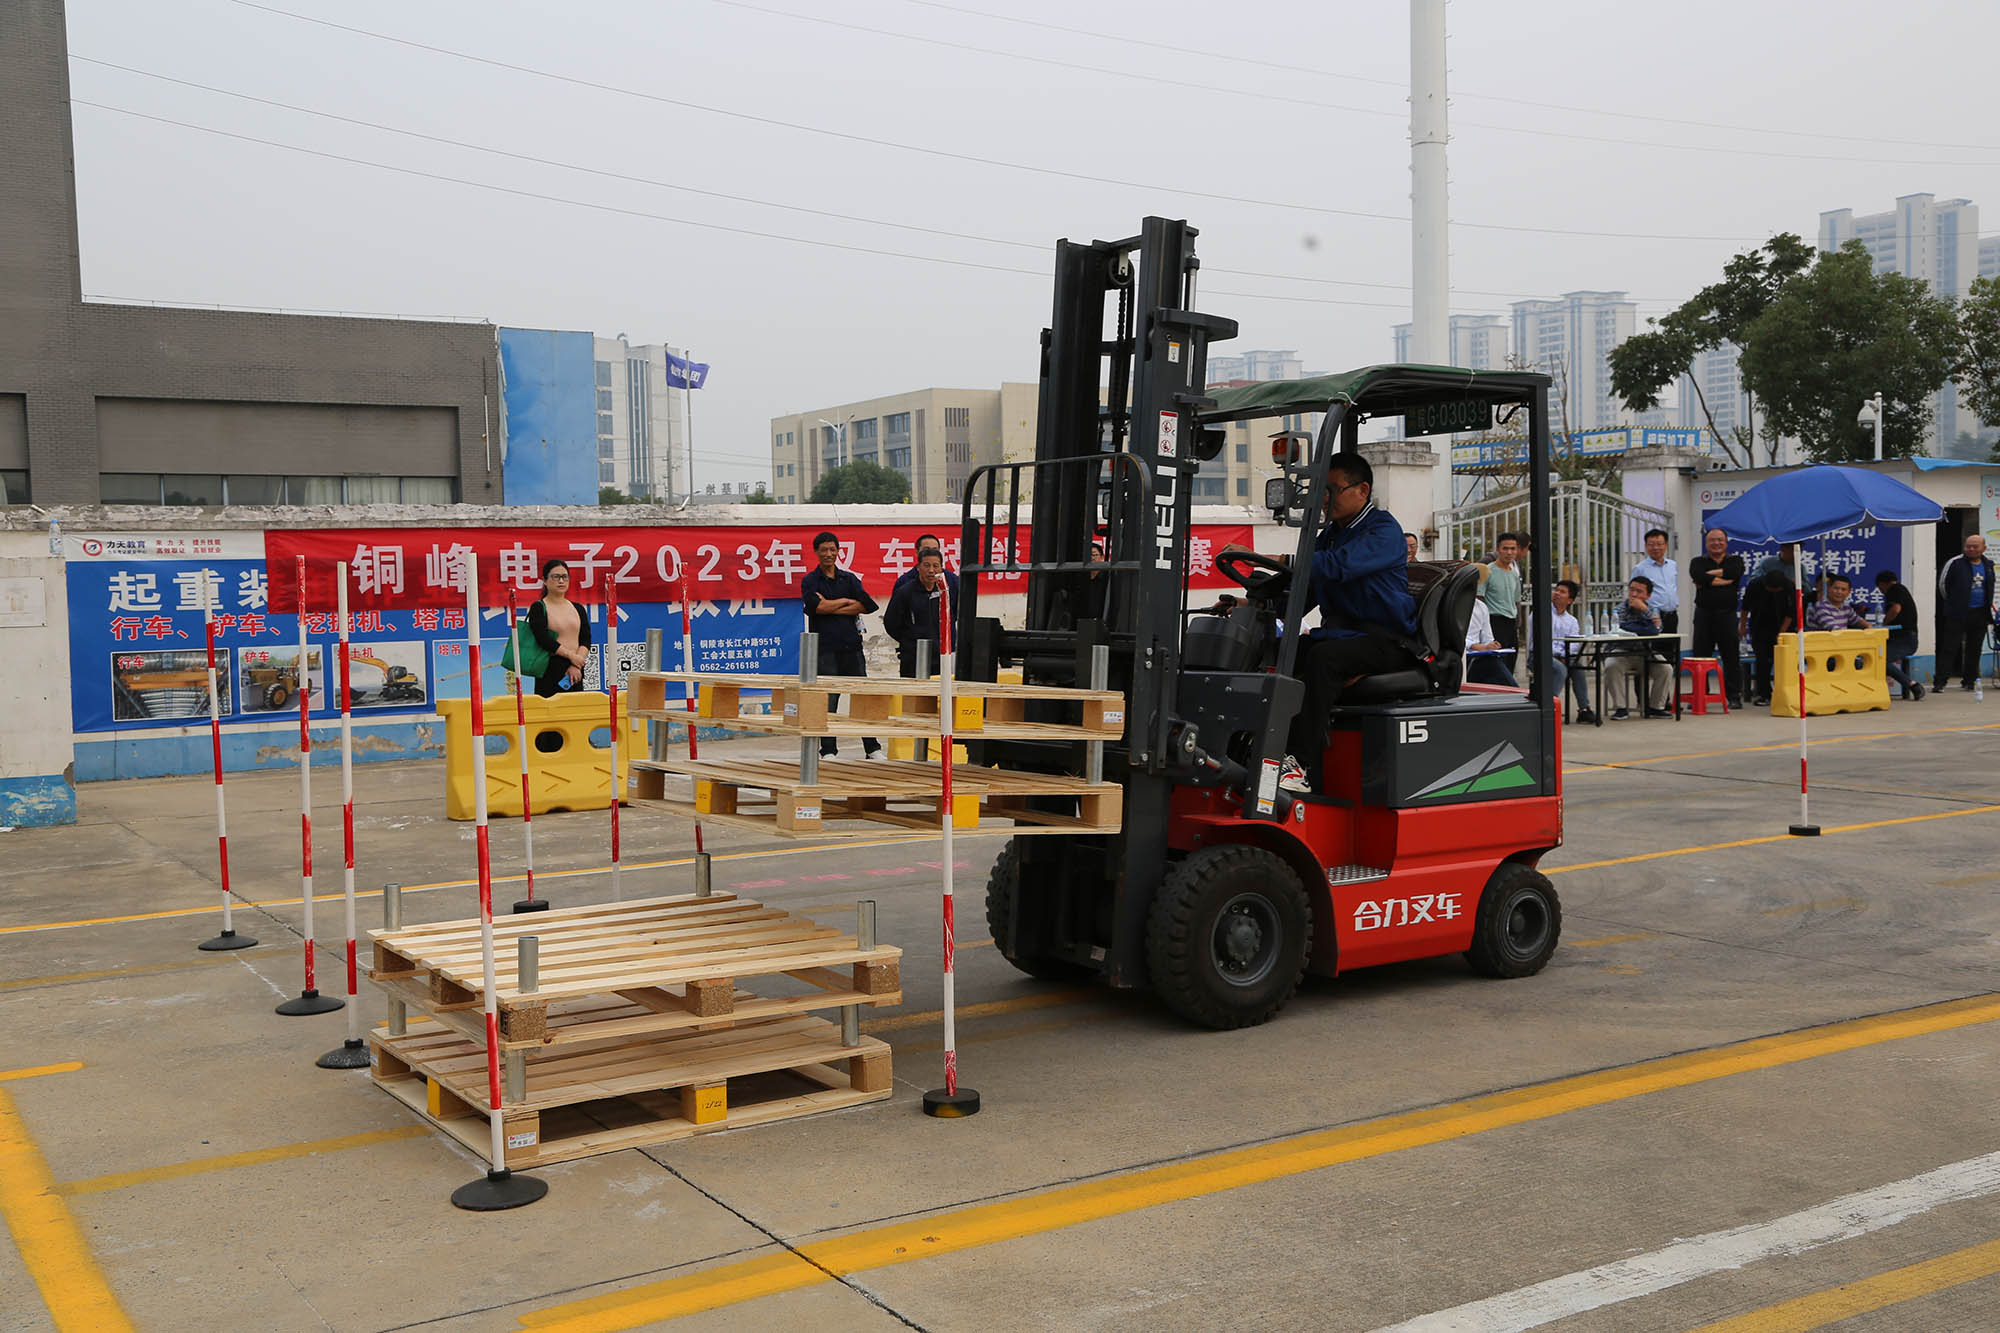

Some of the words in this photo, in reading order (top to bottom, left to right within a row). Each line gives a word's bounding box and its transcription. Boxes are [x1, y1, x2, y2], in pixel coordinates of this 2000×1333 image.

[1155, 464, 1178, 570] HELI
[106, 540, 146, 549] 力天教育
[438, 643, 462, 656] 塔吊
[700, 637, 781, 649] 铜陵市长江中路951号
[244, 651, 270, 663] 铲车
[337, 647, 374, 660] 土机
[117, 656, 145, 669] 行车
[700, 661, 760, 671] 0562-2616188
[1399, 720, 1429, 744] 15
[1352, 892, 1462, 931] 合力叉车
